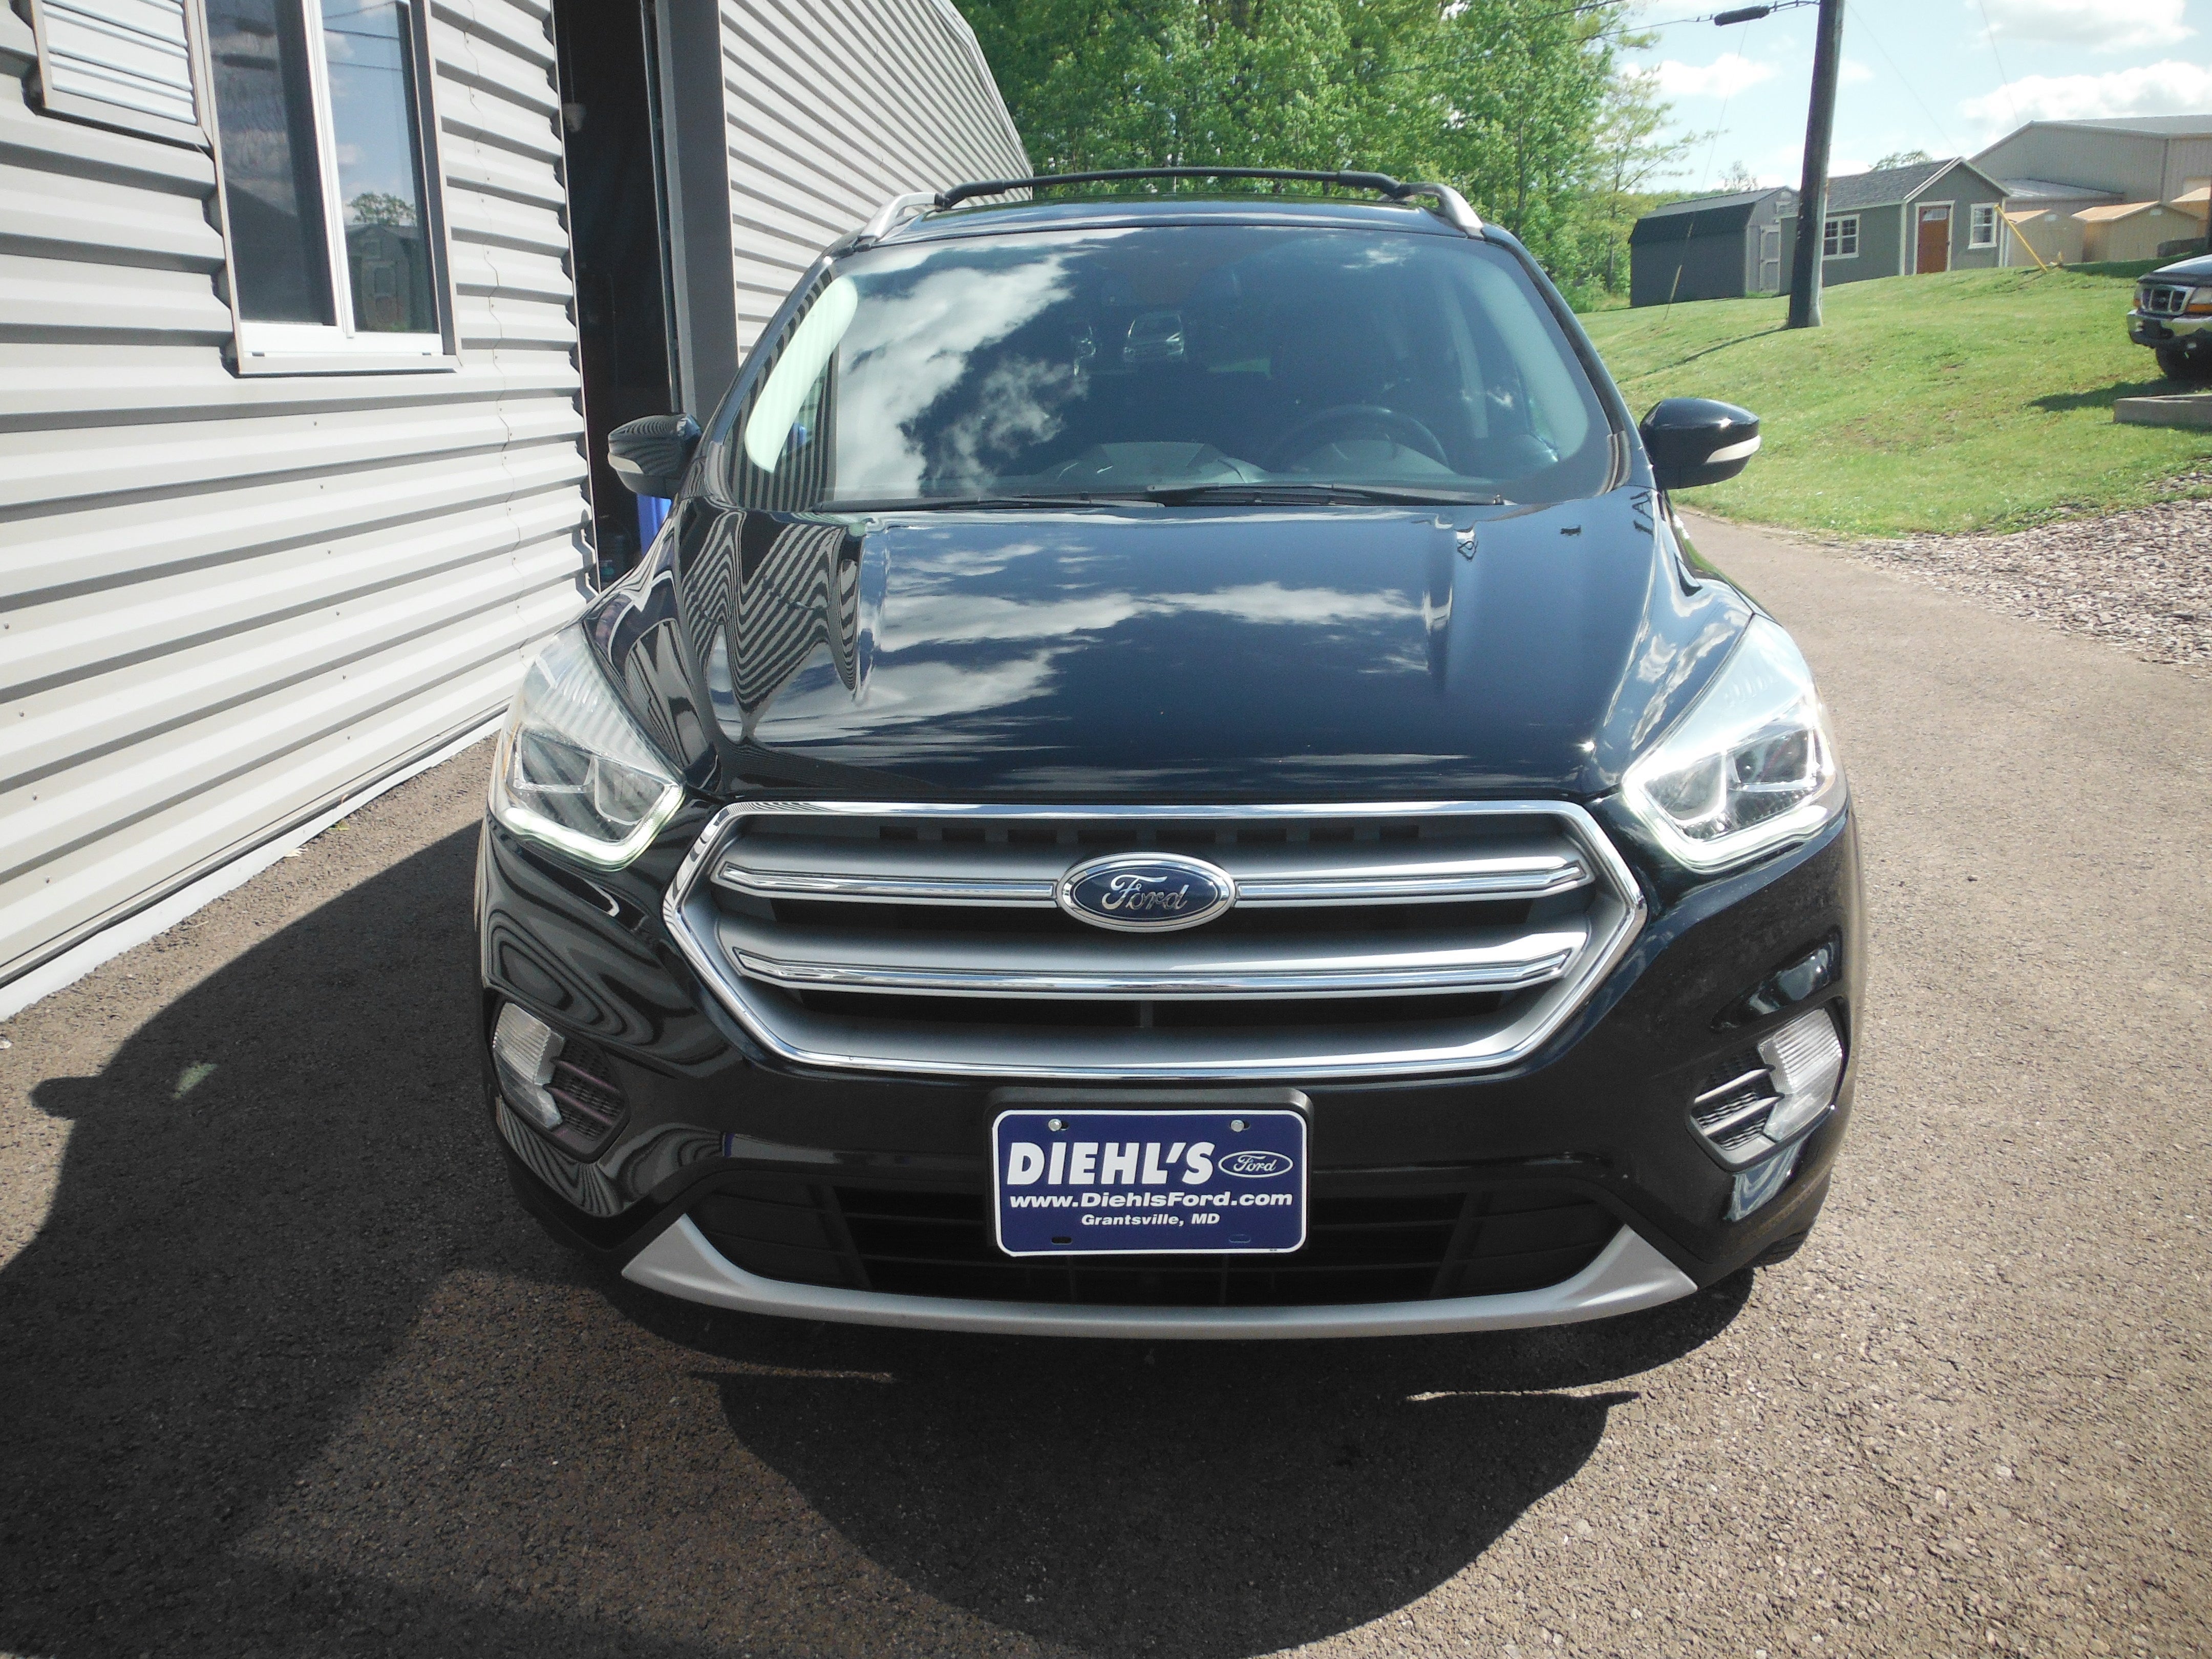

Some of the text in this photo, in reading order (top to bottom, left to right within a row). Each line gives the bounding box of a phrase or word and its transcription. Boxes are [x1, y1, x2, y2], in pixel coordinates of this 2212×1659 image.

[1102, 874, 1189, 910] Ford
[1007, 1142, 1215, 1185] DIEHL'S
[1233, 1155, 1277, 1172] Ford
[1010, 1192, 1293, 1207] www.DiehlsFord.com
[1081, 1213, 1220, 1226] Grantsville, MD
